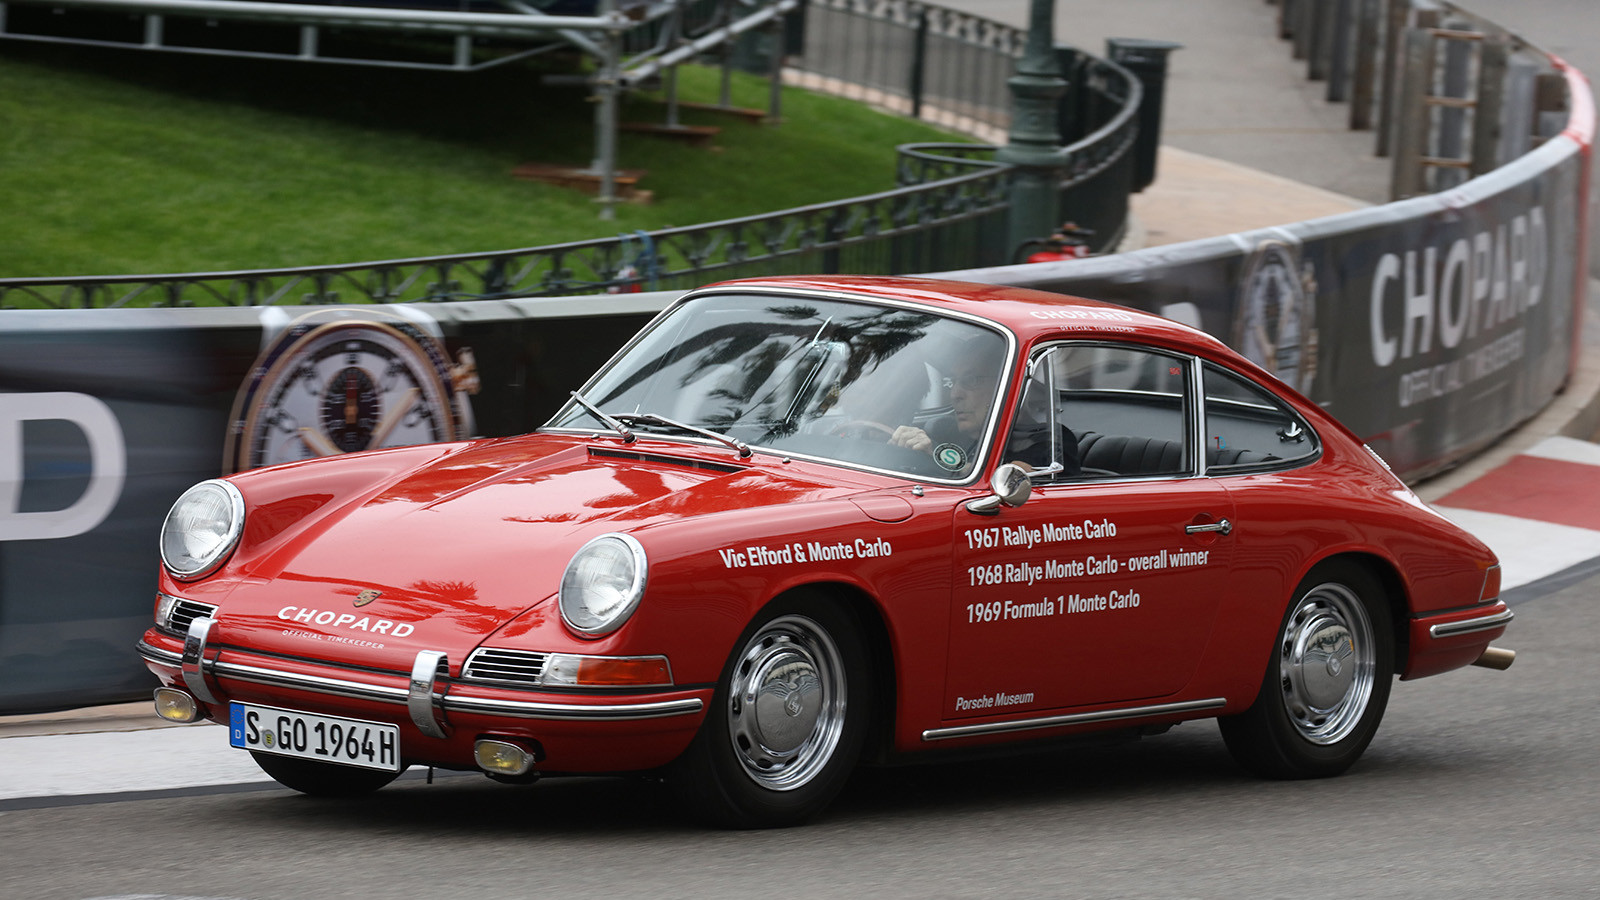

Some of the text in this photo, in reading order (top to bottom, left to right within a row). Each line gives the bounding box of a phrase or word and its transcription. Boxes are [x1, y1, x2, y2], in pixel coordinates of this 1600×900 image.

[1371, 206, 1547, 367] CHOPARD
[1030, 310, 1133, 321] CHOPARD
[964, 518, 1117, 549] 1967 Rallye Monte Carlo
[719, 537, 892, 568] Vic Elford & Monte Carlo
[967, 564, 1002, 586] 1968
[1005, 562, 1043, 586] Rallye
[1045, 558, 1084, 580] Monte
[1086, 554, 1118, 576] Carlo
[1128, 550, 1167, 571] overall
[1169, 548, 1209, 568] winner
[277, 606, 415, 637] CHOPARD
[966, 589, 1140, 623] 1969 Formula 1 Monte Carlo
[282, 630, 385, 649] OFFICIAL TIMEKEEPER
[955, 692, 1034, 711] Porsche Museum
[246, 711, 260, 744] S
[277, 716, 307, 752] GO
